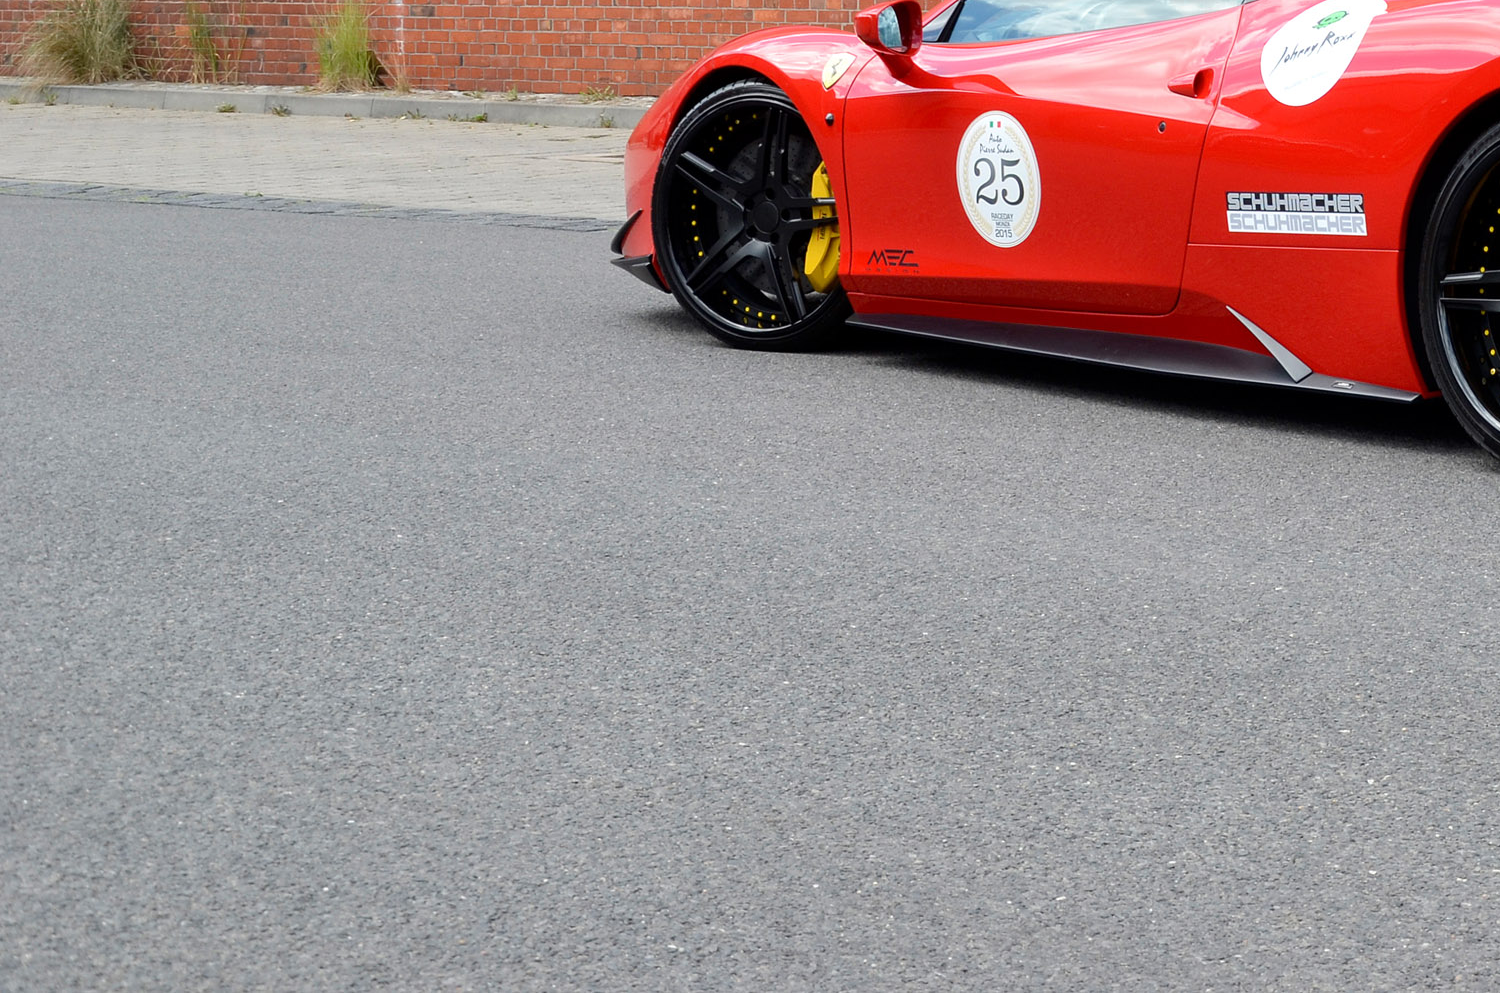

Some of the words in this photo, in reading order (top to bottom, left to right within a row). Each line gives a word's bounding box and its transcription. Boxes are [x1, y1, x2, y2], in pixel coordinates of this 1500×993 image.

[1269, 43, 1318, 76] Johnny
[1317, 30, 1357, 54] Roxx
[988, 133, 1003, 143] Auto
[973, 157, 1025, 206] 25
[990, 212, 1014, 220] RACEDAY
[995, 229, 1013, 238] 2015
[867, 249, 919, 267] MEC
